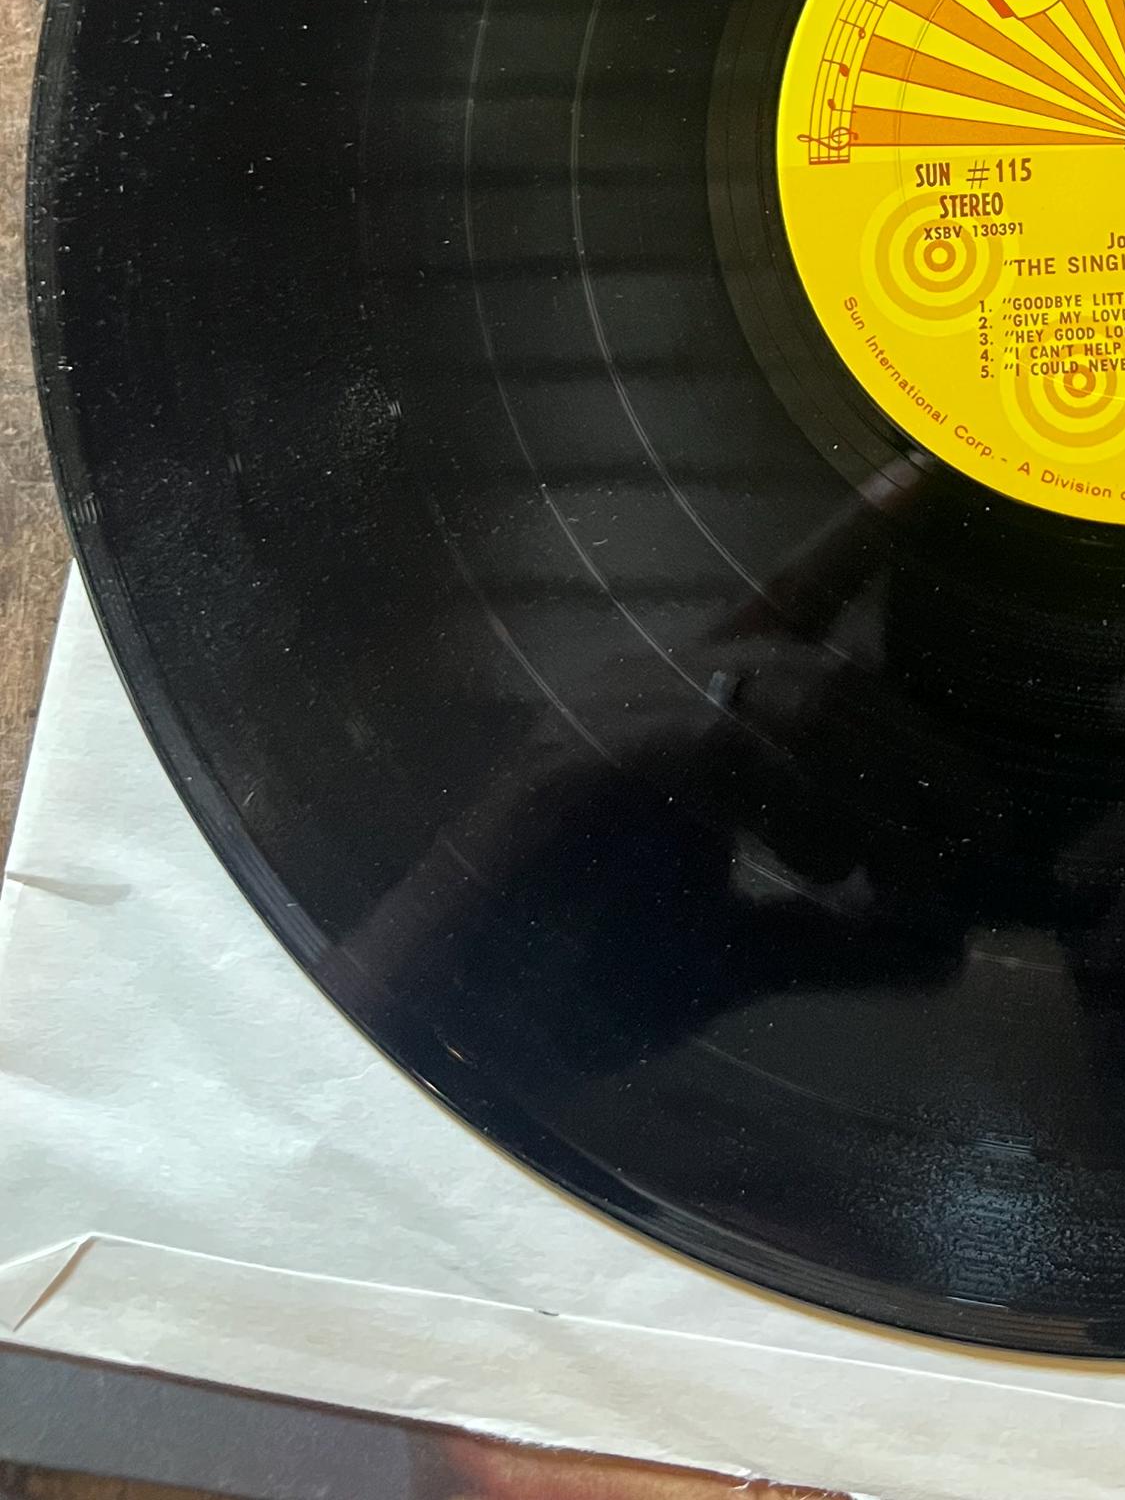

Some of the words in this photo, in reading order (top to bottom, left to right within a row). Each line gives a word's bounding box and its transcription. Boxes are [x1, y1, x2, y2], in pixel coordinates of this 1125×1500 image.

[916, 162, 950, 187] SUN
[966, 158, 1032, 189] #115
[939, 192, 1003, 219] STEREO
[924, 225, 962, 240] XSBV
[973, 222, 1023, 237] 130391
[1004, 258, 1056, 276] "THE
[979, 300, 992, 313] 1.
[1002, 294, 1082, 311] "GOODBYE
[978, 317, 993, 330] 2.
[1002, 313, 1049, 327] "GIVE
[1059, 311, 1081, 324] MY
[979, 333, 993, 346] 3.
[1004, 329, 1044, 344] "HEY
[1054, 327, 1095, 341] GOOD
[980, 349, 994, 362] 4.
[1004, 347, 1020, 360] "I
[1030, 344, 1074, 359] CAN'T
[1084, 342, 1121, 356] HELP
[980, 366, 994, 378] 5.
[1004, 364, 1020, 376] "I
[1031, 361, 1079, 376] COULD
[844, 297, 865, 330] Sun
[865, 335, 948, 425] International
[954, 425, 995, 459] Corp.
[1018, 462, 1031, 475] A
[1041, 470, 1111, 498] Division
